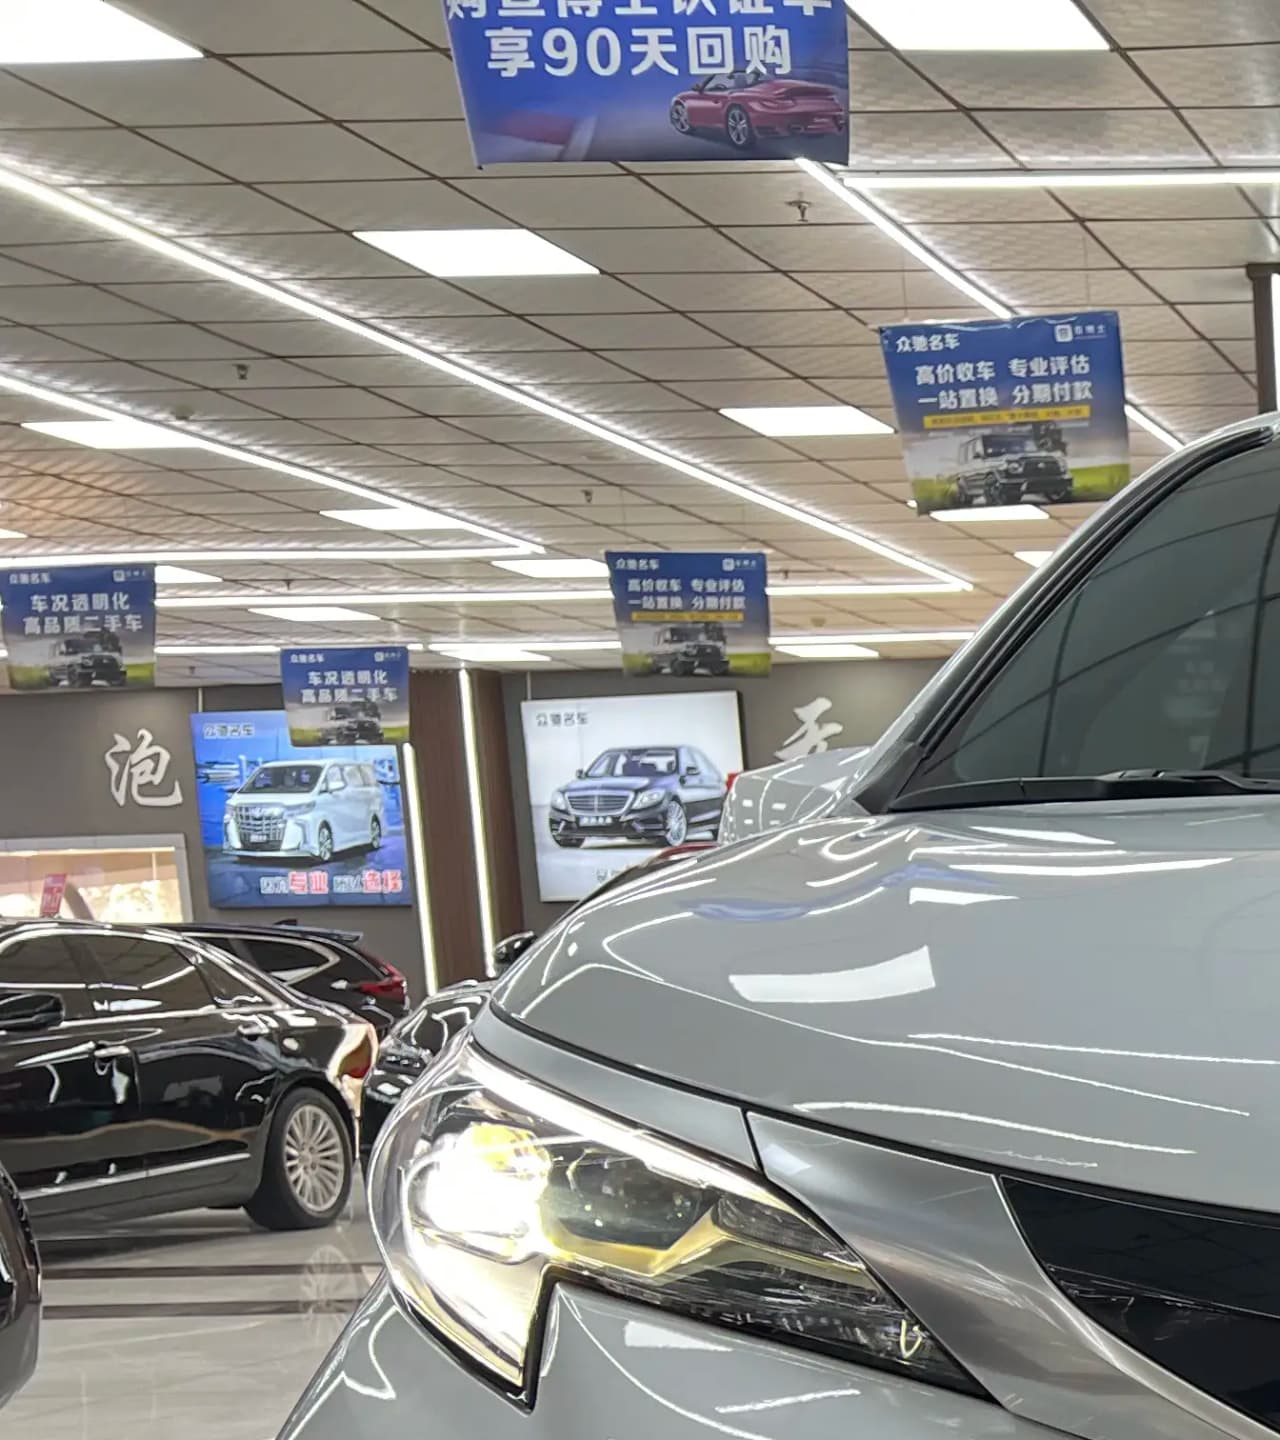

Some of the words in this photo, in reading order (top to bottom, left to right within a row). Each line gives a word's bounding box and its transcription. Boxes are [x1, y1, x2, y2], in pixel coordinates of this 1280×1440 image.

[485, 25, 792, 78] 享90天回购
[896, 333, 960, 352] 众驰名车
[915, 360, 996, 385] 高价收车
[1008, 354, 1090, 378] 专业评估
[918, 387, 998, 410] 一站置换
[1012, 381, 1093, 405] 分期付款
[30, 591, 130, 612] 车况透明化
[23, 614, 143, 635] 高品质二手车
[104, 728, 182, 807] 泡
